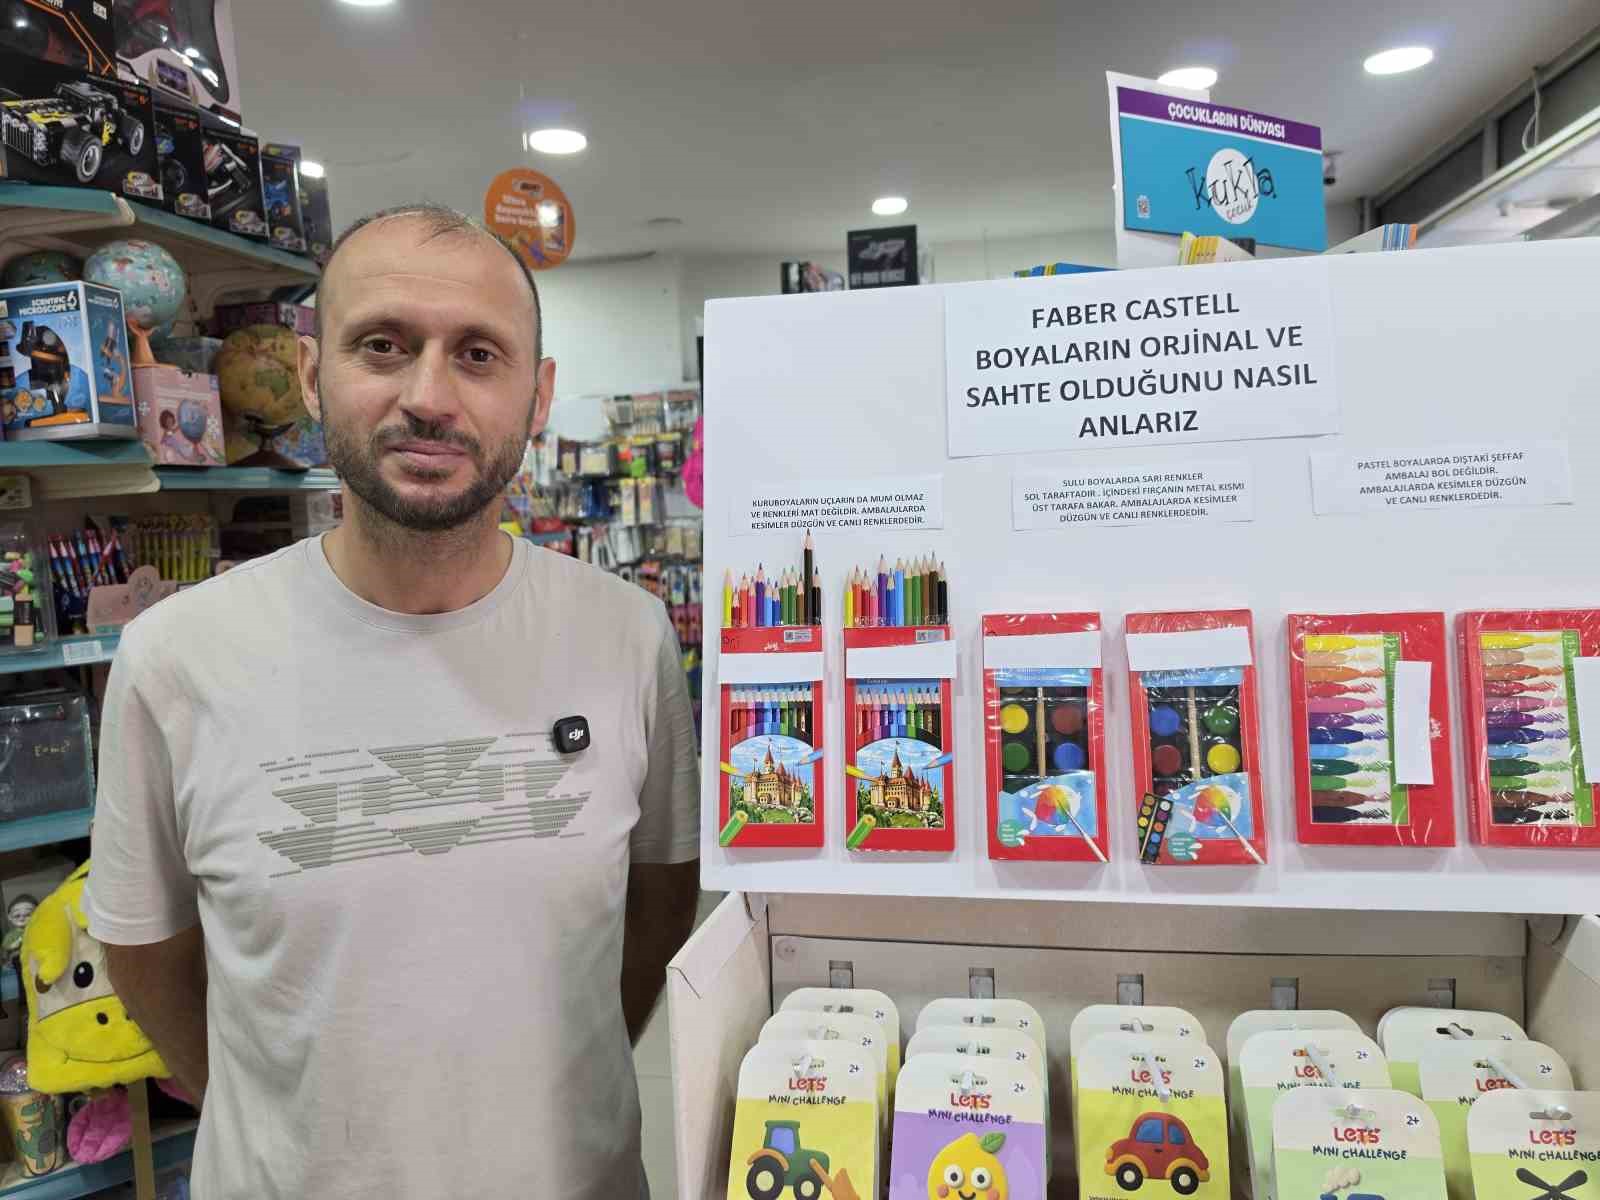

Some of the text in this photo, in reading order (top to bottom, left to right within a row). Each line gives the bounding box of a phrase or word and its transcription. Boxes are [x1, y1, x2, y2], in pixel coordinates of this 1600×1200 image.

[1168, 102, 1285, 139] ÇOCUKLARIN DÜNYASI
[19, 304, 67, 315] MICROSCOPE
[1031, 292, 1240, 329] FABER CASTELL
[975, 325, 1303, 371] BOYALARIN ORJİNAL VE
[966, 363, 1318, 408] SAHTE OLDUĞUNU NASIL
[1078, 410, 1199, 438] ANLARIZ
[1358, 452, 1523, 470] PASTEL BOYALARDA DIŞTAKİ ŞEFFAF
[1063, 472, 1203, 487] SULU BOYALARDA SARI RENKLER
[1385, 466, 1498, 481] AMBALAJ BOL DEĞİLDİR.
[1024, 493, 1040, 501] SOL
[1142, 485, 1184, 496] FIRÇANIN
[1186, 483, 1217, 493] METAL
[1219, 482, 1245, 491] KISMI
[1360, 476, 1526, 494] AMBALAJLARDA KESİMLER DÜZGÜN
[752, 498, 818, 507] KURUBOYALARIN
[820, 496, 854, 506] UÇLARIN
[870, 495, 893, 503] MUM
[894, 493, 924, 502] OLMAZ
[1032, 494, 1237, 512] ÜST TARAFA BAKAR. AMBALAJLARDA KESİMLER
[1385, 491, 1502, 505] VE CANLI RENKLERDEDİR.
[762, 509, 799, 518] RENKLERİ
[801, 509, 818, 517] MAT
[820, 506, 859, 516] DEĞİLDİR.
[861, 505, 925, 514] AMBALAJLARDA
[1059, 508, 1208, 523] DÜZGÜN VE CANLI RENKLERDEDİR.
[751, 515, 925, 529] KESİMLER DÜZGÜN VE CANLI RENKLERDEDİR.
[568, 728, 584, 741] dji
[875, 1010, 885, 1019] 2+
[1018, 1019, 1029, 1028] 2+
[1179, 1028, 1190, 1036] 2+
[862, 1037, 873, 1046] 2+
[1016, 1051, 1027, 1061] 2+
[1356, 1050, 1368, 1060] 2+
[849, 1063, 860, 1073] 2+
[1194, 1059, 1206, 1068] 2+
[1540, 1064, 1552, 1074] 2+
[1013, 1084, 1025, 1093] 2+
[1112, 1086, 1194, 1099] MINI CHANGE
[768, 1094, 847, 1106] MINI CHALLENGE
[927, 1108, 1012, 1125] MINI CHALLENGE
[1406, 1115, 1420, 1126] 2+
[1312, 1145, 1407, 1160] MINI CHALLENGE
[1508, 1147, 1535, 1159] MINI
